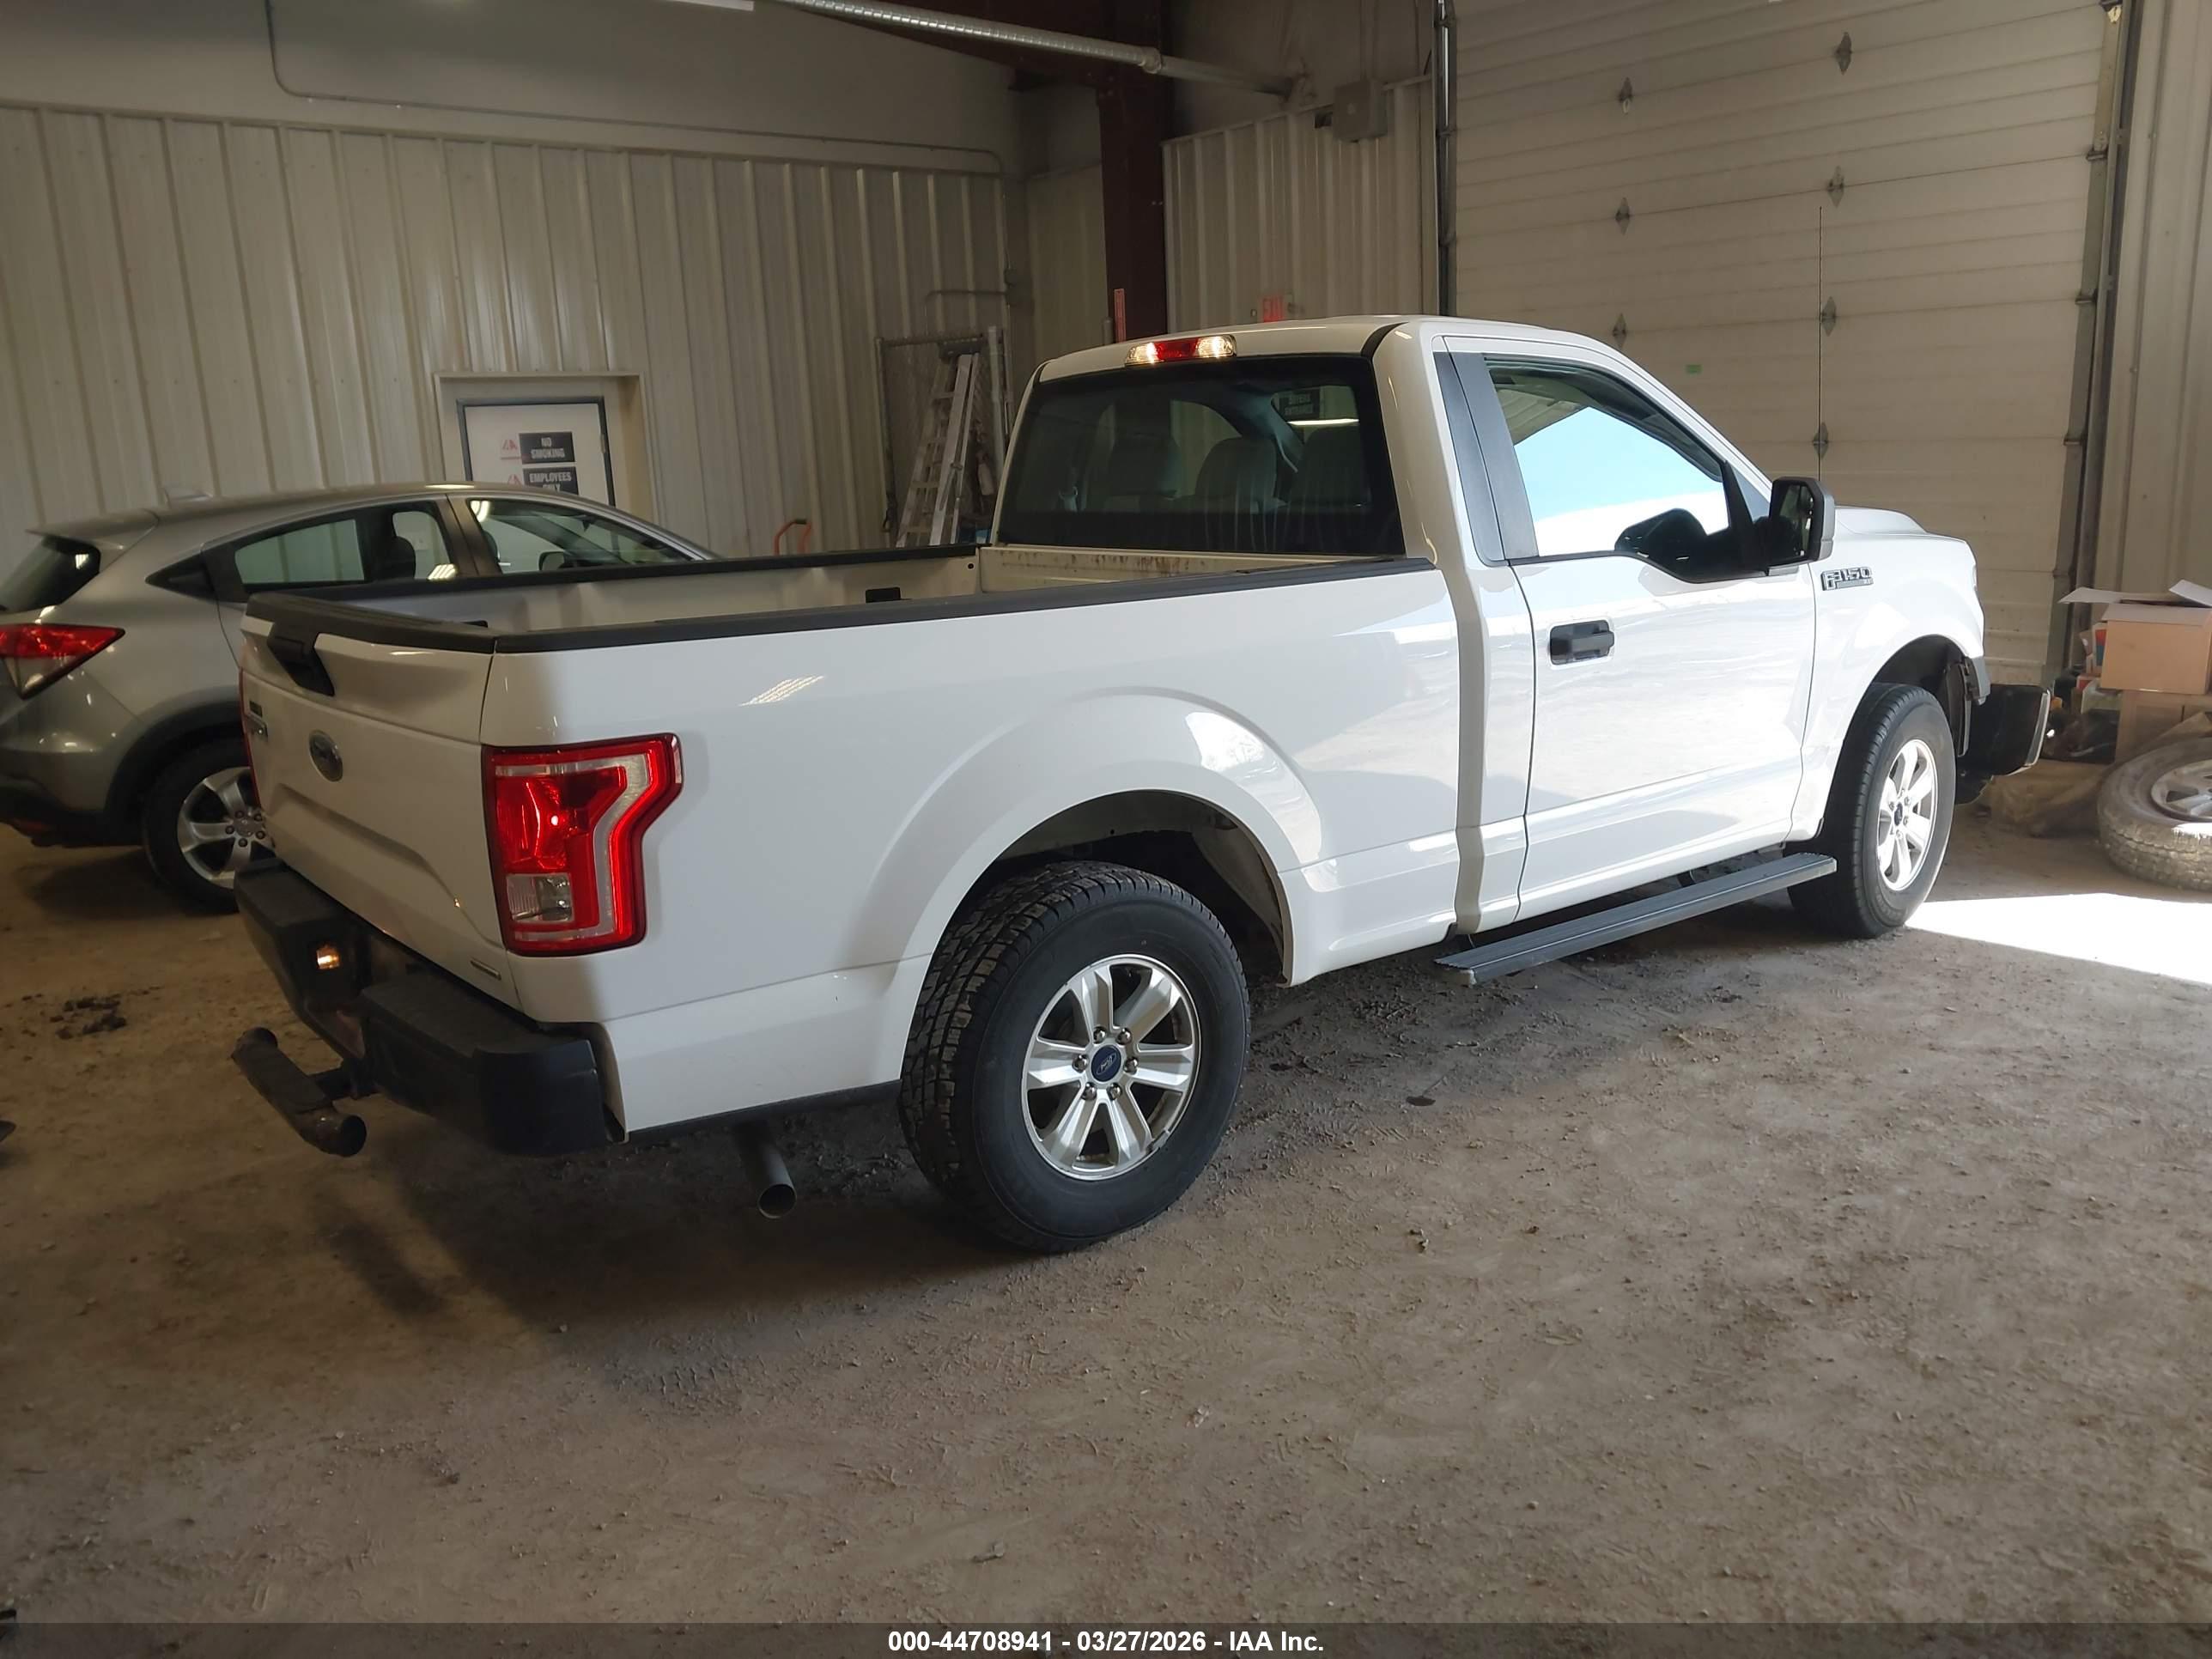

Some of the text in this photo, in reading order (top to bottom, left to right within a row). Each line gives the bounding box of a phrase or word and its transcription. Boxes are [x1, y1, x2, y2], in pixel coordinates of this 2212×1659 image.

[541, 436, 552, 447] NO
[531, 447, 566, 459] SMOKING
[529, 471, 572, 483] EMPLOYEES
